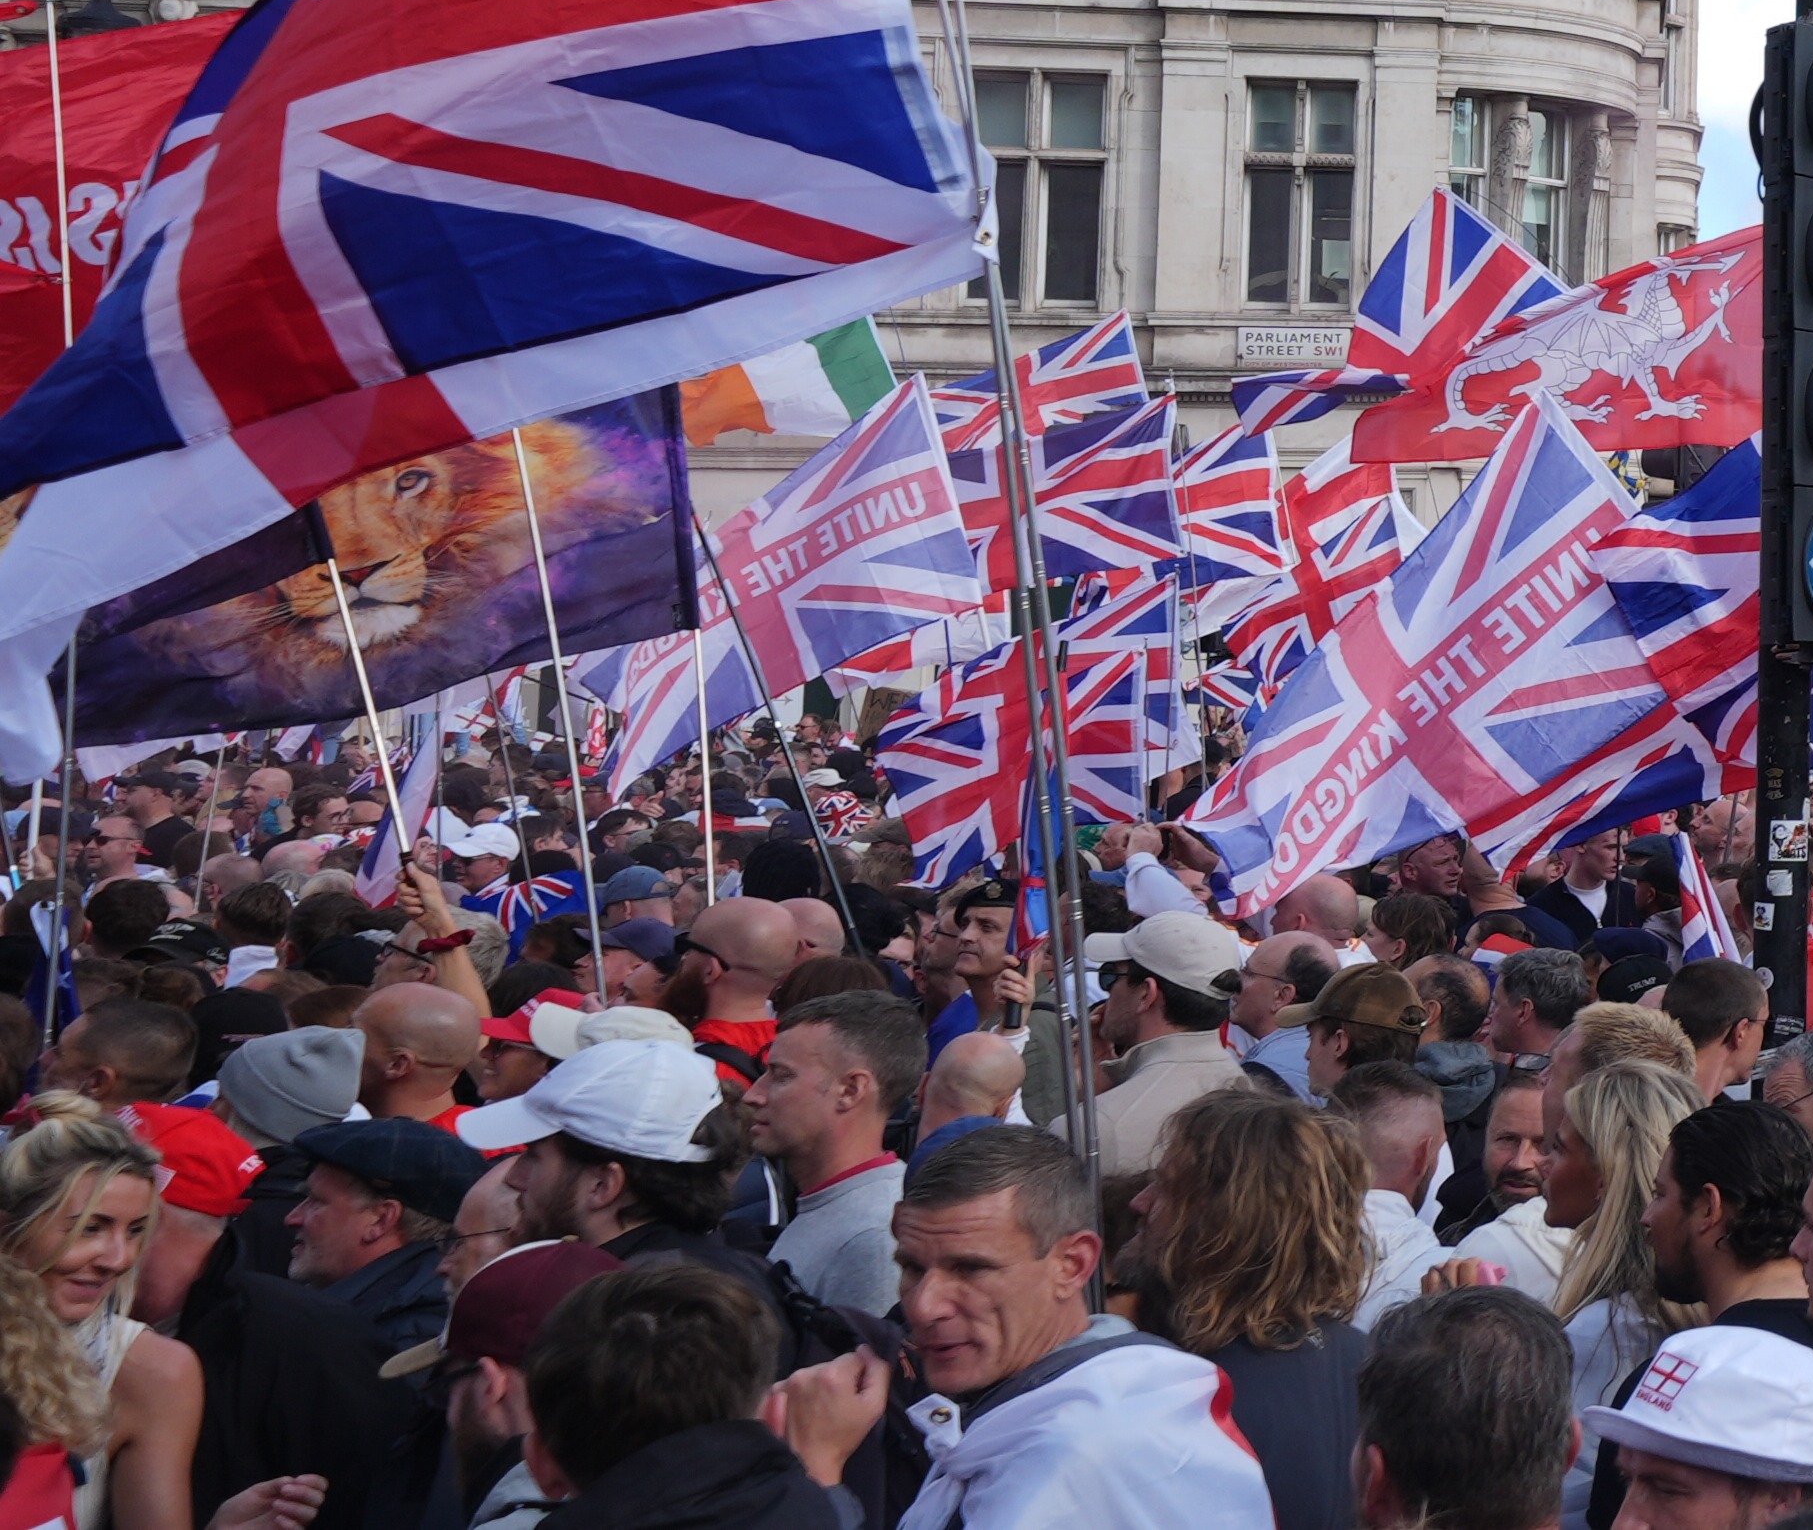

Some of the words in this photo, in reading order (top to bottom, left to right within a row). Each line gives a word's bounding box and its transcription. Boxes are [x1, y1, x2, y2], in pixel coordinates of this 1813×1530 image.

[1245, 332, 1343, 343] PARLIAMENT
[1246, 345, 1304, 356] STREET
[1313, 346, 1343, 356] SW1
[1627, 976, 1657, 993] TRUMP
